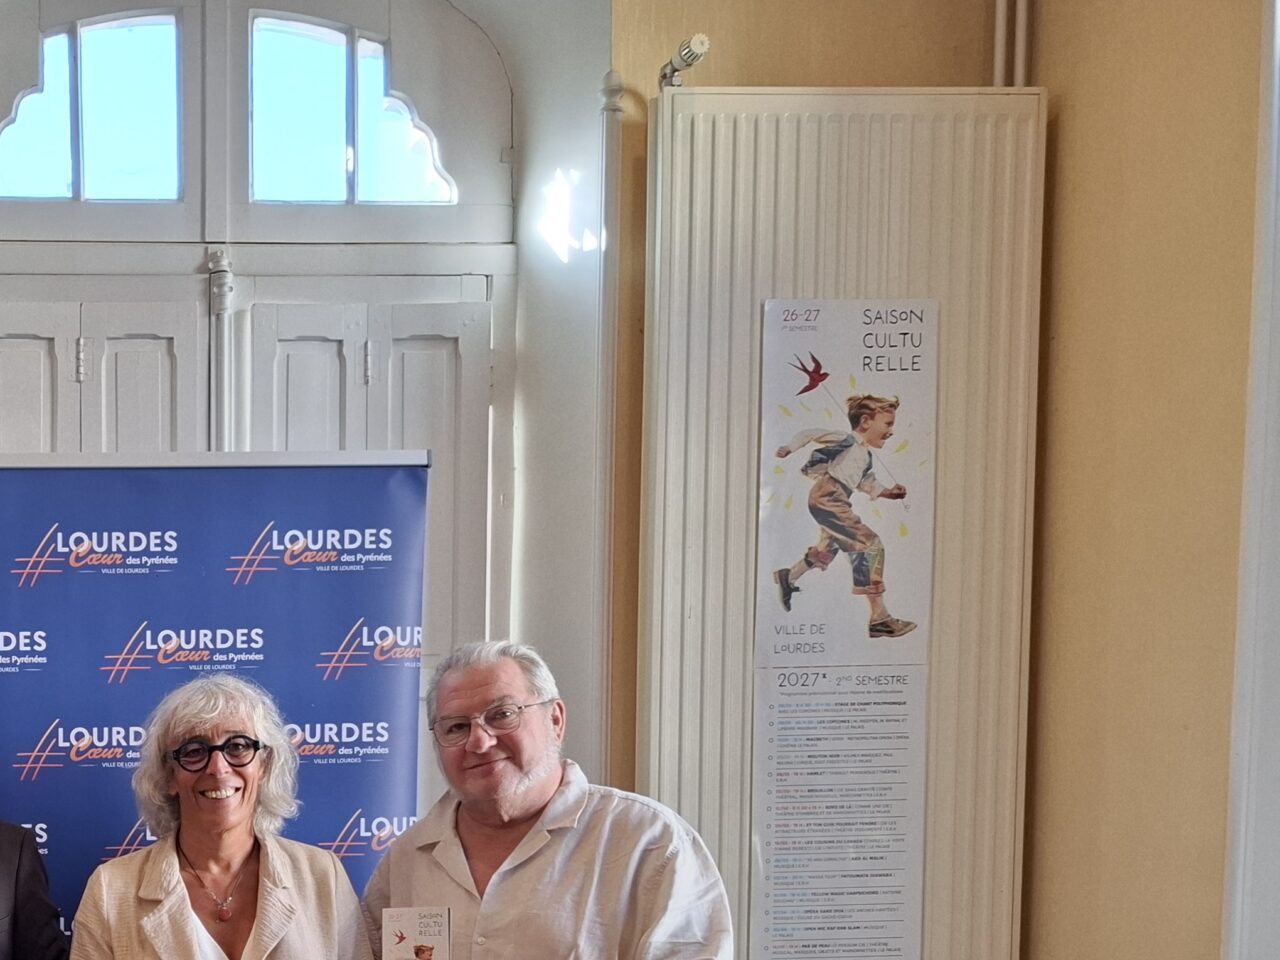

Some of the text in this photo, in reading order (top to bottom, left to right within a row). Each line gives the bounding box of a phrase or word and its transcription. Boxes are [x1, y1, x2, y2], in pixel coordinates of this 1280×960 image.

[783, 309, 820, 322] 26-27
[863, 309, 923, 325] SAISON
[863, 333, 922, 348] CULTU
[863, 355, 921, 371] RELLE
[57, 531, 178, 552] LOURDES
[272, 528, 393, 550] LOURDES
[126, 556, 140, 565] des
[141, 555, 178, 567] Pyrénées
[340, 553, 355, 562] des
[356, 552, 393, 564] Pyrénées
[774, 623, 826, 635] VILLE DE
[146, 628, 264, 650] LOURDES
[774, 642, 825, 654] LOURDES
[12, 655, 47, 667] Pyrénées
[213, 653, 227, 662] des
[228, 652, 264, 663] Pyrénées
[855, 675, 909, 686] SEMESTRE
[283, 722, 389, 744] OURDES
[290, 733, 389, 756] œur des Pyrénées
